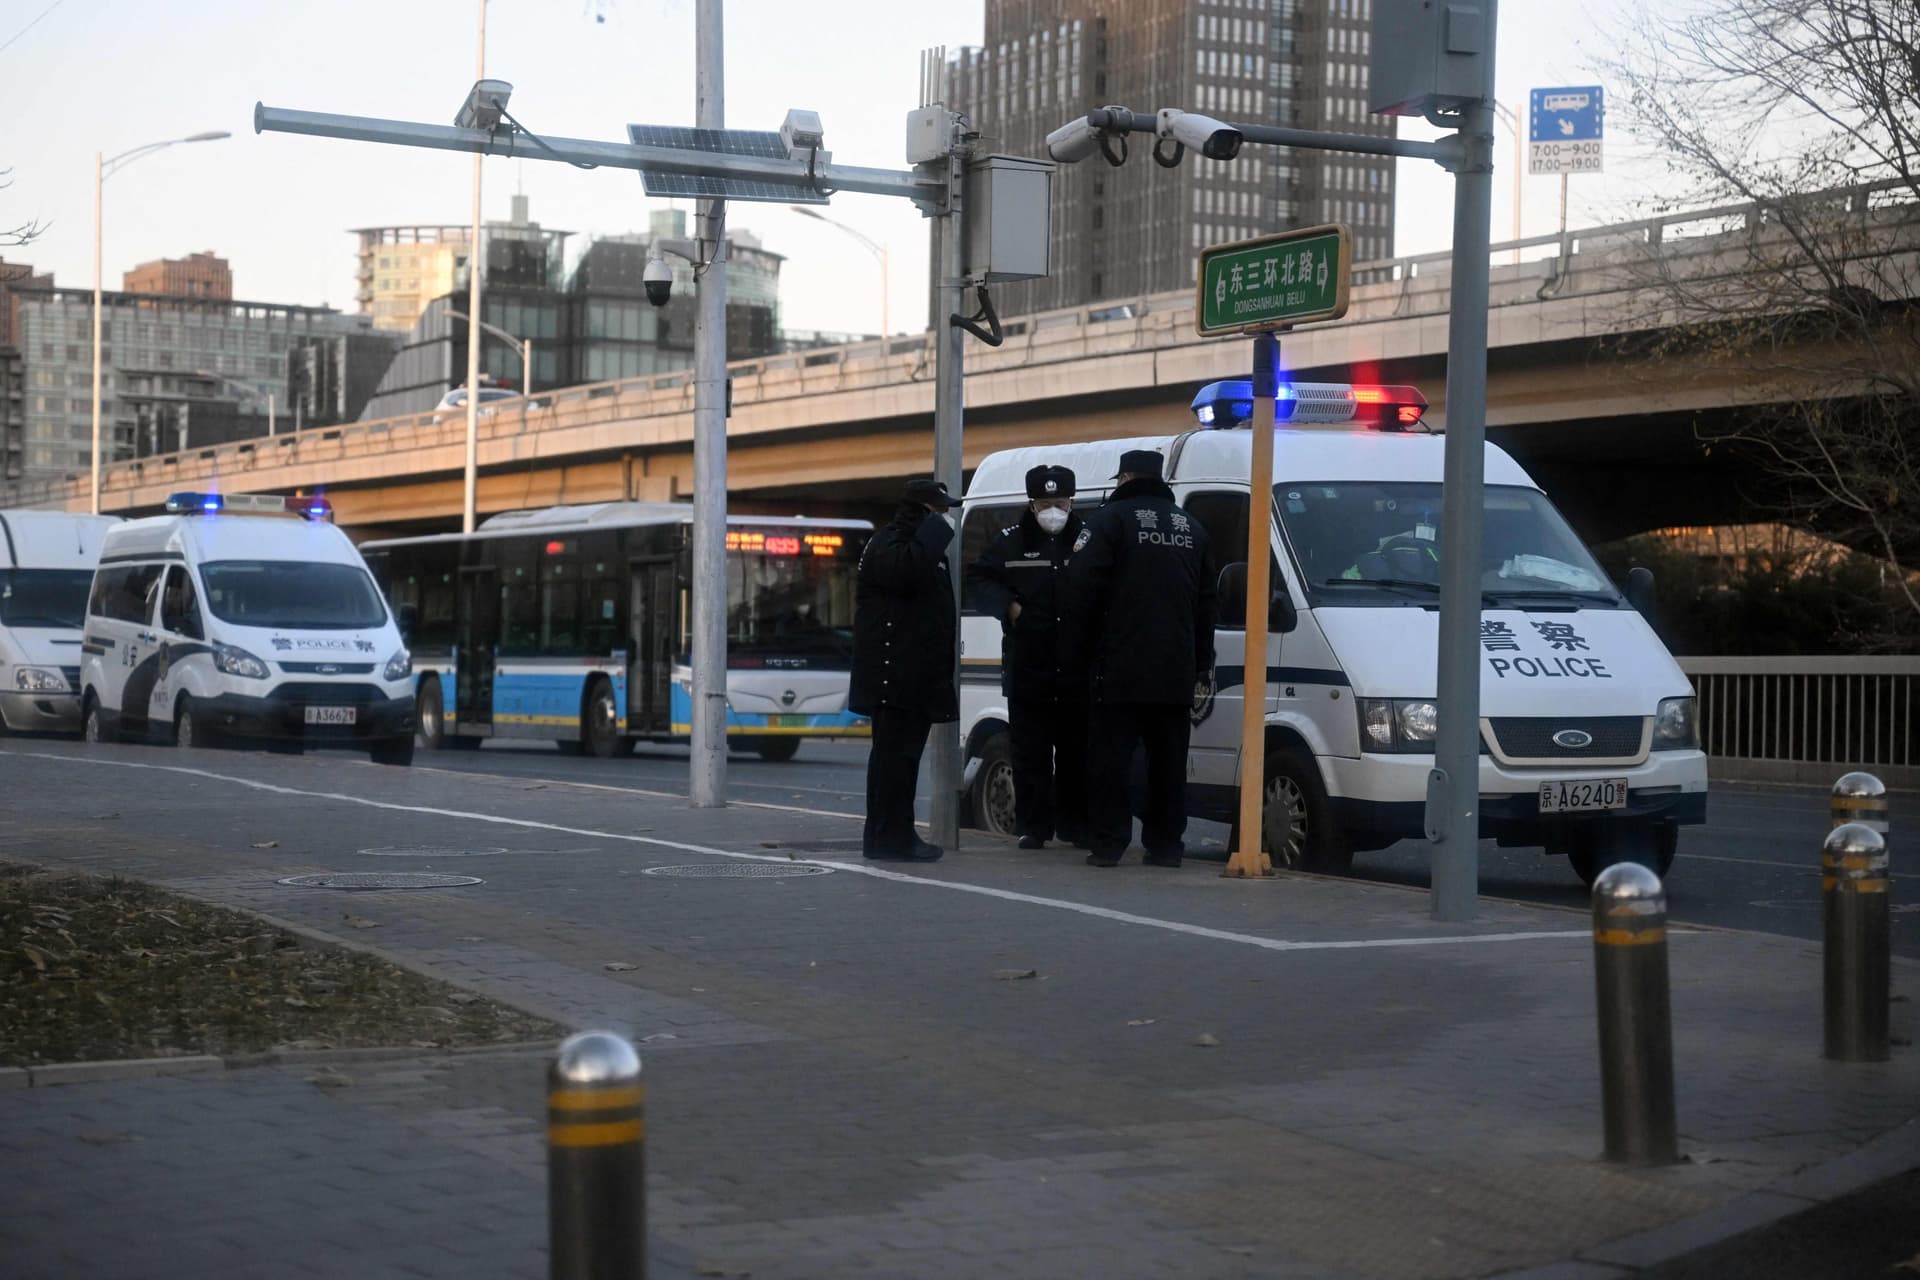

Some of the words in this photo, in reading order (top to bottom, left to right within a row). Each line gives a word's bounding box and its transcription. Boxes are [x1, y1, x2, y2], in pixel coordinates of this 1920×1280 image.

[1230, 250, 1313, 294] 东三环北路
[1234, 294, 1285, 315] DONGSANHUAN
[1134, 508, 1191, 532] 警察
[1138, 531, 1194, 549] POLICE
[1481, 620, 1591, 651] 警察
[1488, 657, 1613, 678] POLICE
